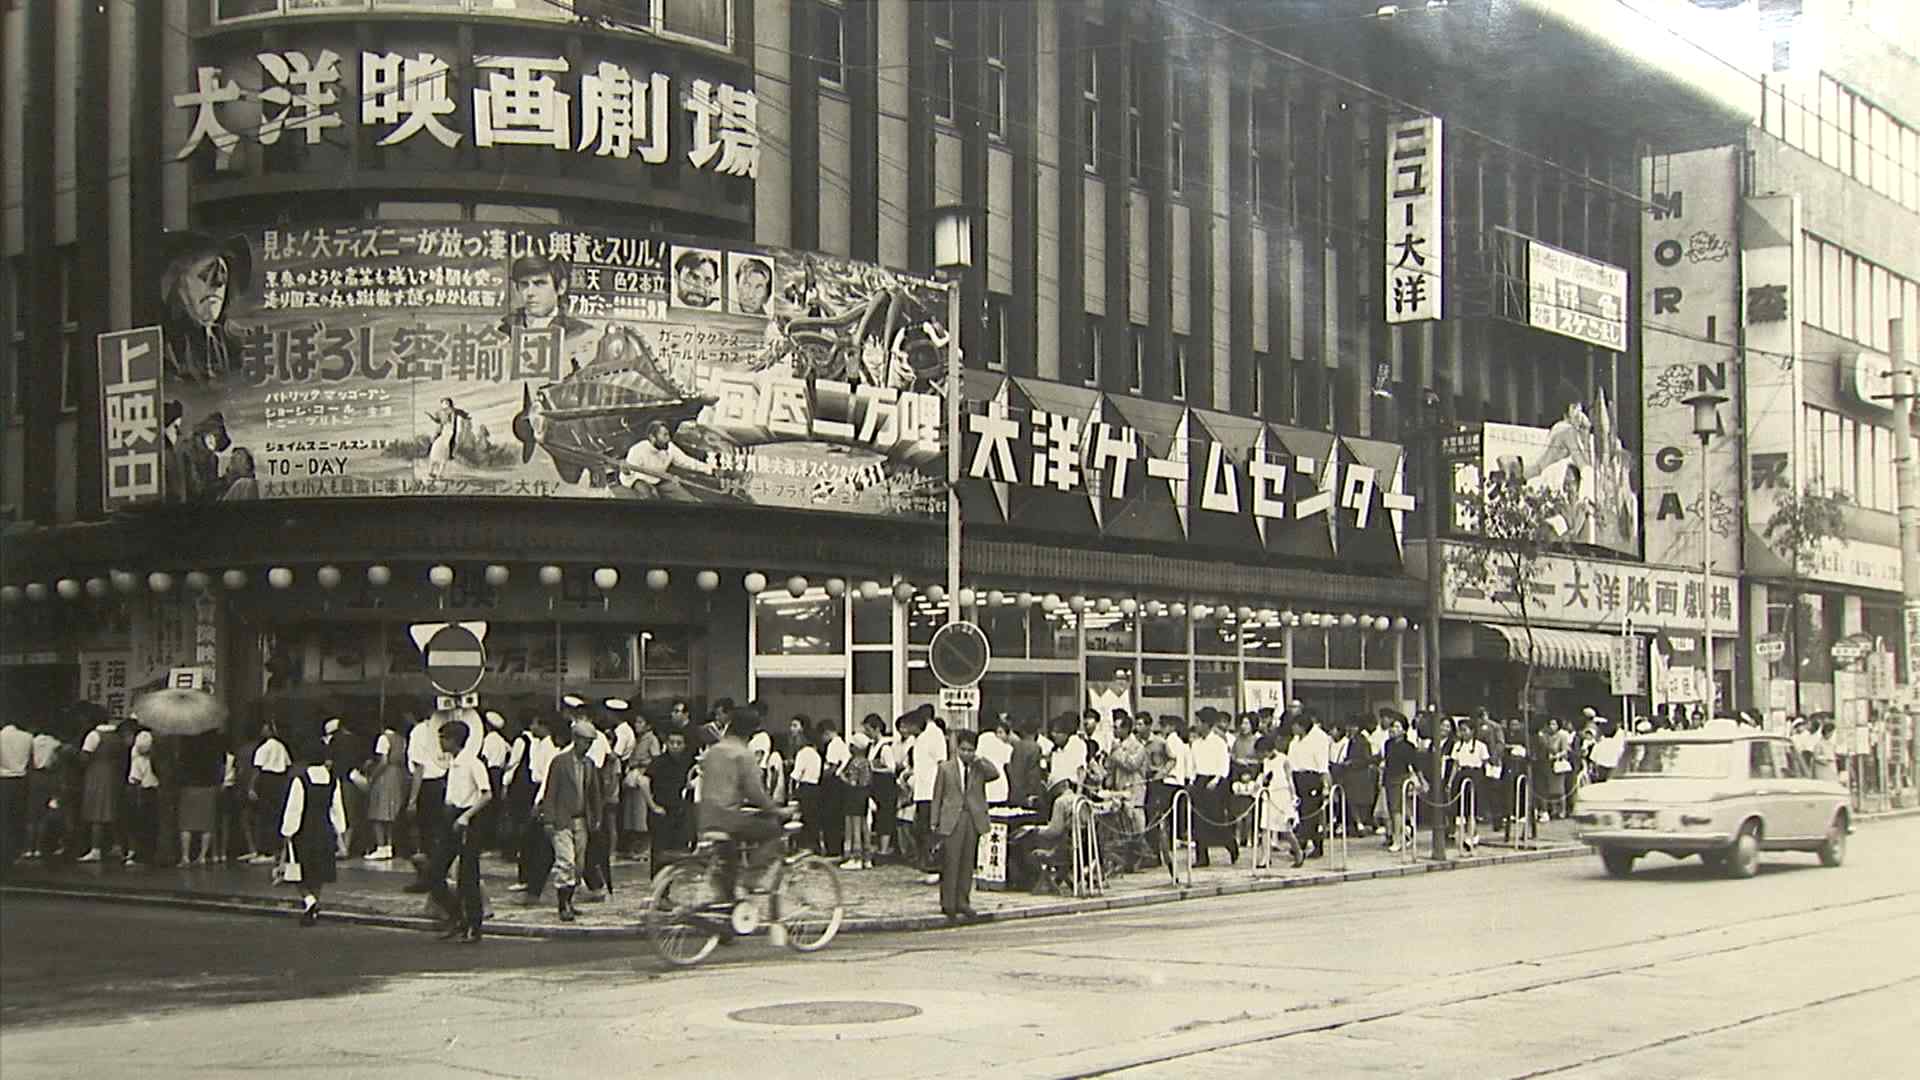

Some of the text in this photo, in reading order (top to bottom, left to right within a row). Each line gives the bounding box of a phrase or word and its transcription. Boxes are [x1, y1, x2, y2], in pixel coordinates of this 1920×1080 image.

[174, 50, 760, 178] 大洋映画劇場
[1393, 127, 1426, 313] ニュー大洋
[104, 338, 159, 501] 上映中
[1653, 190, 1726, 521] MORINGA
[267, 458, 349, 476] TO-DAY
[968, 401, 1416, 529] 大洋ゲームセンター
